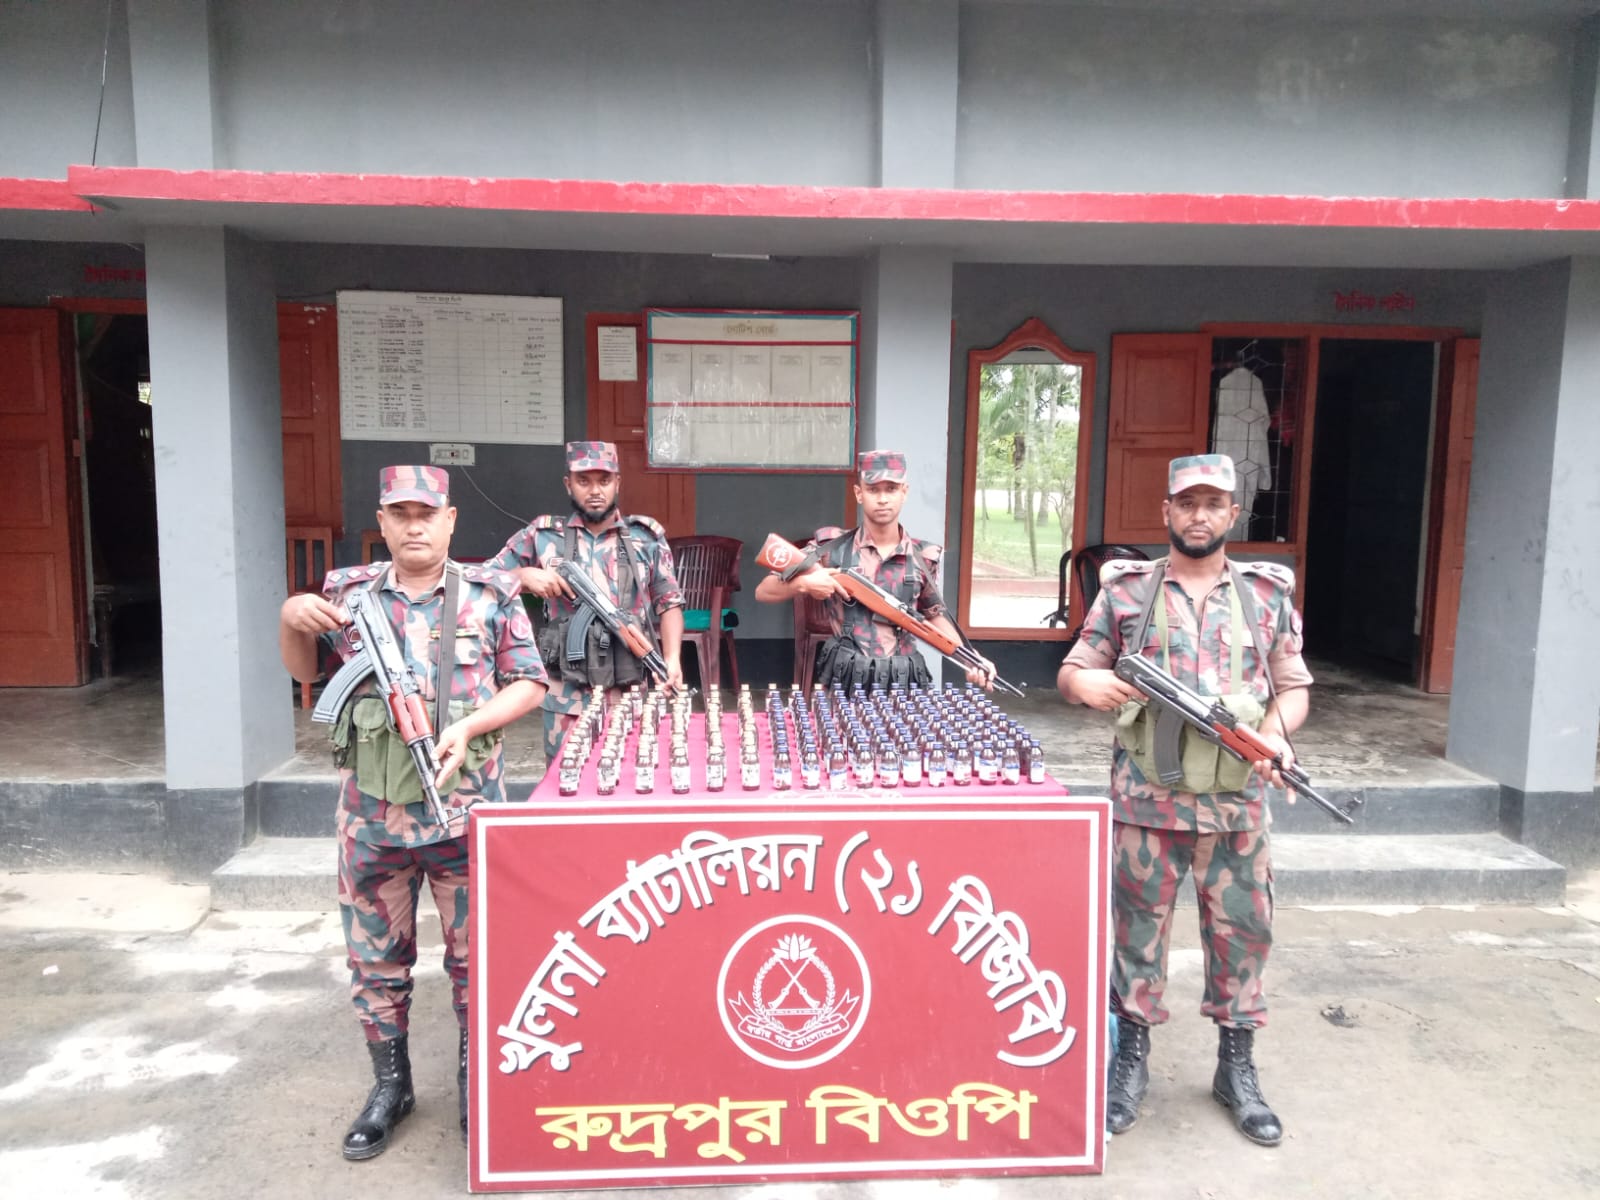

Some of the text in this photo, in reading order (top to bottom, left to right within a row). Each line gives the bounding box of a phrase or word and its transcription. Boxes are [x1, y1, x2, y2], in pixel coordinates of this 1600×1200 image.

[497, 829, 1078, 1077] খুলনা ব্যাটালিয়ন (২১ বিজিবি)
[535, 1082, 1038, 1164] রুদ্রপুর বিওপি
